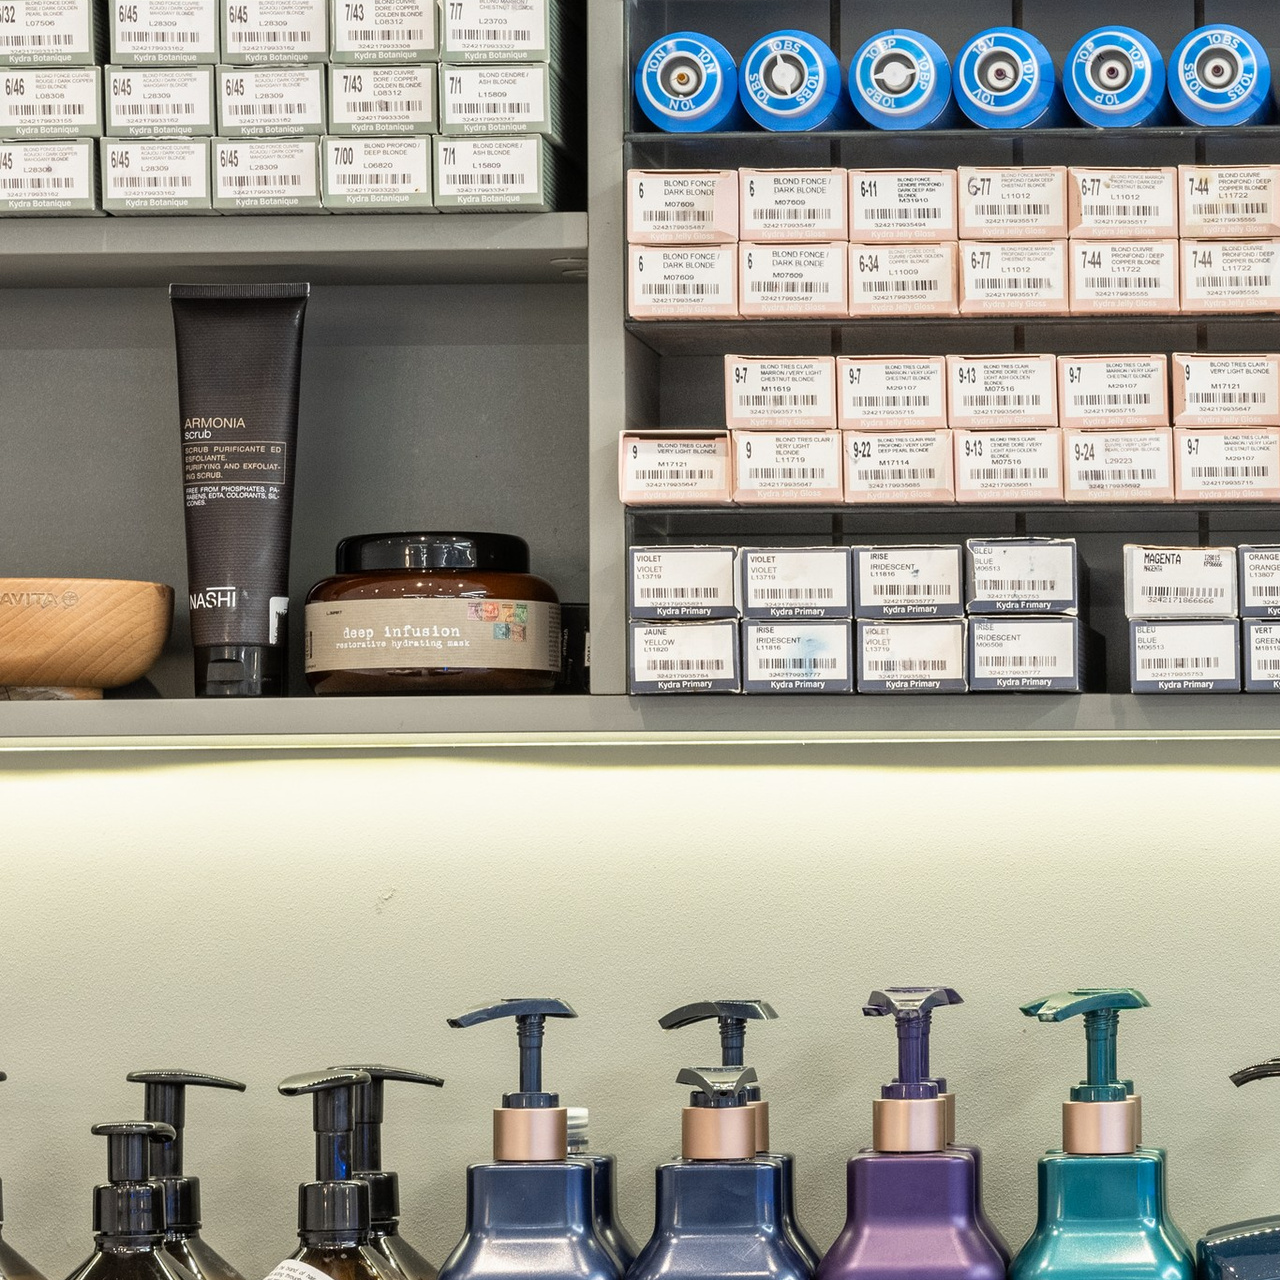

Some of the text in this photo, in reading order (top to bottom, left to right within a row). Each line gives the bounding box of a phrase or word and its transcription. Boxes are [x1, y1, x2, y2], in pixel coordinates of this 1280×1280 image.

[5, 78, 25, 97] 6/46
[343, 75, 363, 94] 7/43
[773, 177, 824, 186] BLOND FONCE
[1189, 178, 1209, 195] 7-44
[638, 182, 644, 198] 6
[773, 186, 827, 194] DARK BLONDE
[860, 180, 877, 197] 6-11
[958, 367, 976, 383] 9-13
[184, 417, 245, 429] ARMONIA
[184, 430, 211, 440] scrub
[636, 555, 661, 563] VIOLET
[1144, 553, 1181, 565] MAGENTA
[1249, 553, 1279, 561] ORANGE
[190, 591, 236, 610] NASHI
[657, 606, 712, 616] Kydra Primary
[343, 625, 461, 641] deep infusion
[335, 639, 470, 649] restorative hydrating mask
